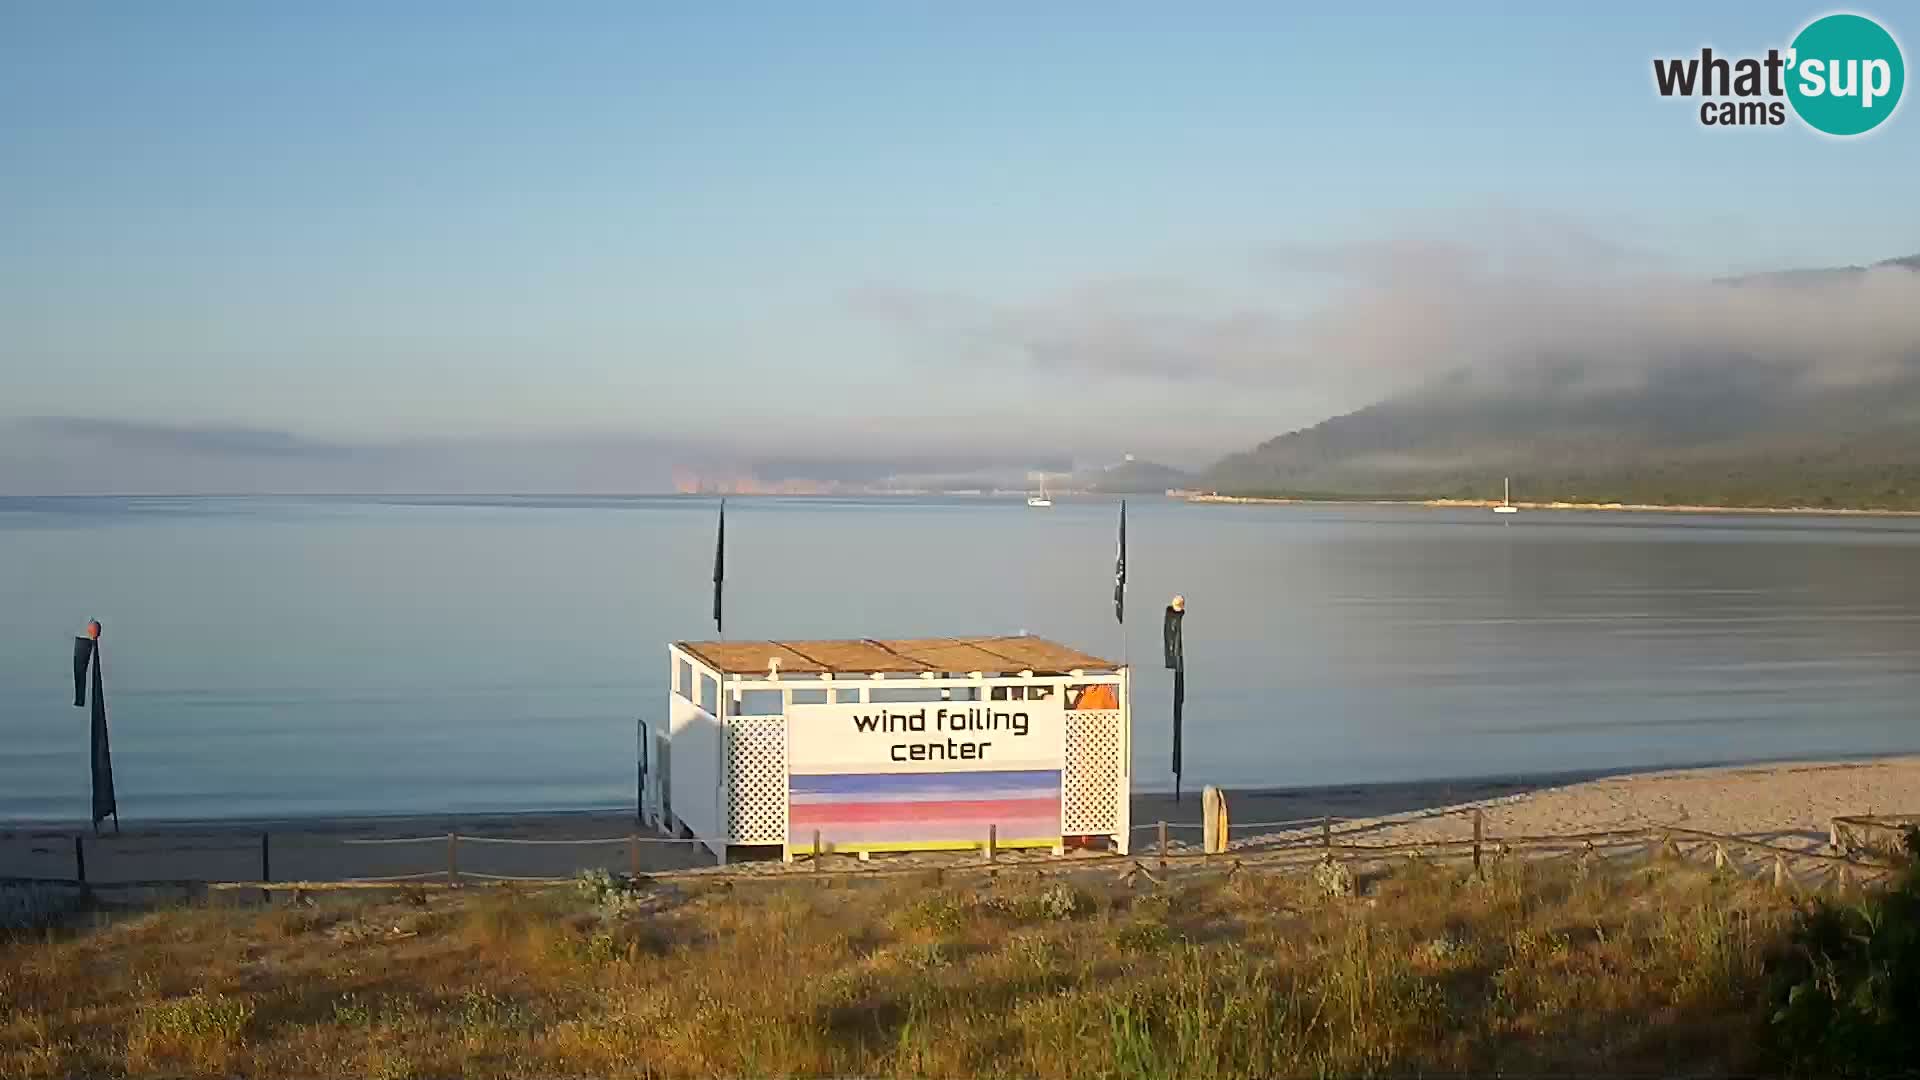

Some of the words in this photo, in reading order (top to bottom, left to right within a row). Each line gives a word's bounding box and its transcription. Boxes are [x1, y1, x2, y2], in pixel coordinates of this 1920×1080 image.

[853, 709, 926, 733] wind
[936, 707, 1030, 736] foiling
[890, 737, 992, 762] center
